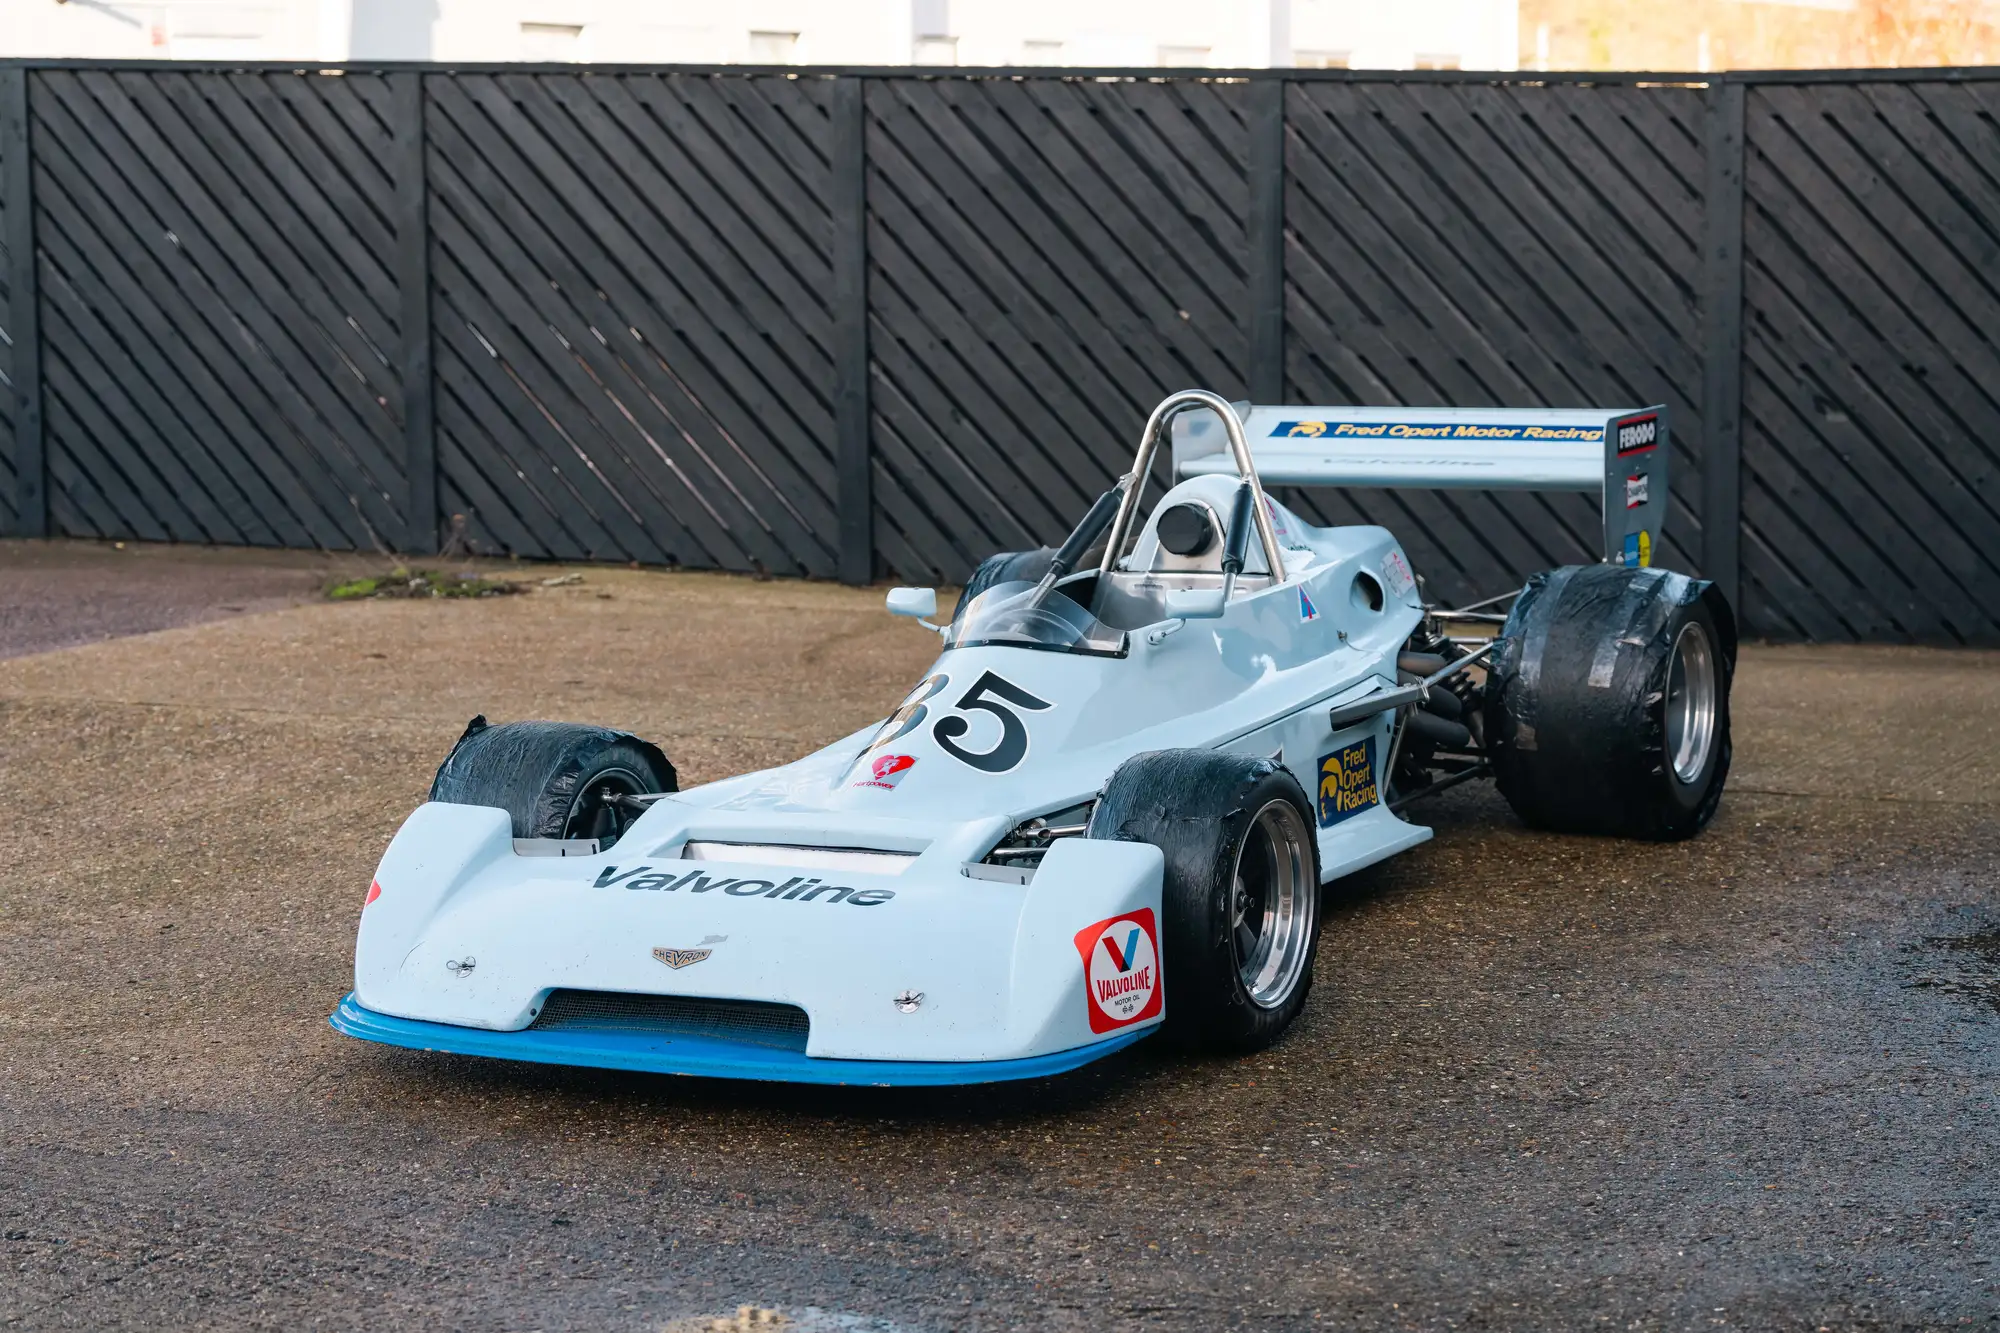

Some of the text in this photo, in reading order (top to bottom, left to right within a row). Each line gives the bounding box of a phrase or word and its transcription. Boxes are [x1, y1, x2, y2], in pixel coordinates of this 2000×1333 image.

[1333, 423, 1603, 441] Fred Opert Motor Racing
[1619, 422, 1656, 449] FERODO
[1343, 743, 1366, 769] Fred
[1343, 763, 1371, 791] Opert
[1343, 783, 1378, 812] Racing
[592, 866, 897, 907] Valvoline
[653, 948, 708, 966] CHEVRON
[1096, 965, 1151, 1004] VALVOLINE
[1114, 994, 1141, 1007] MOTOR OIL
